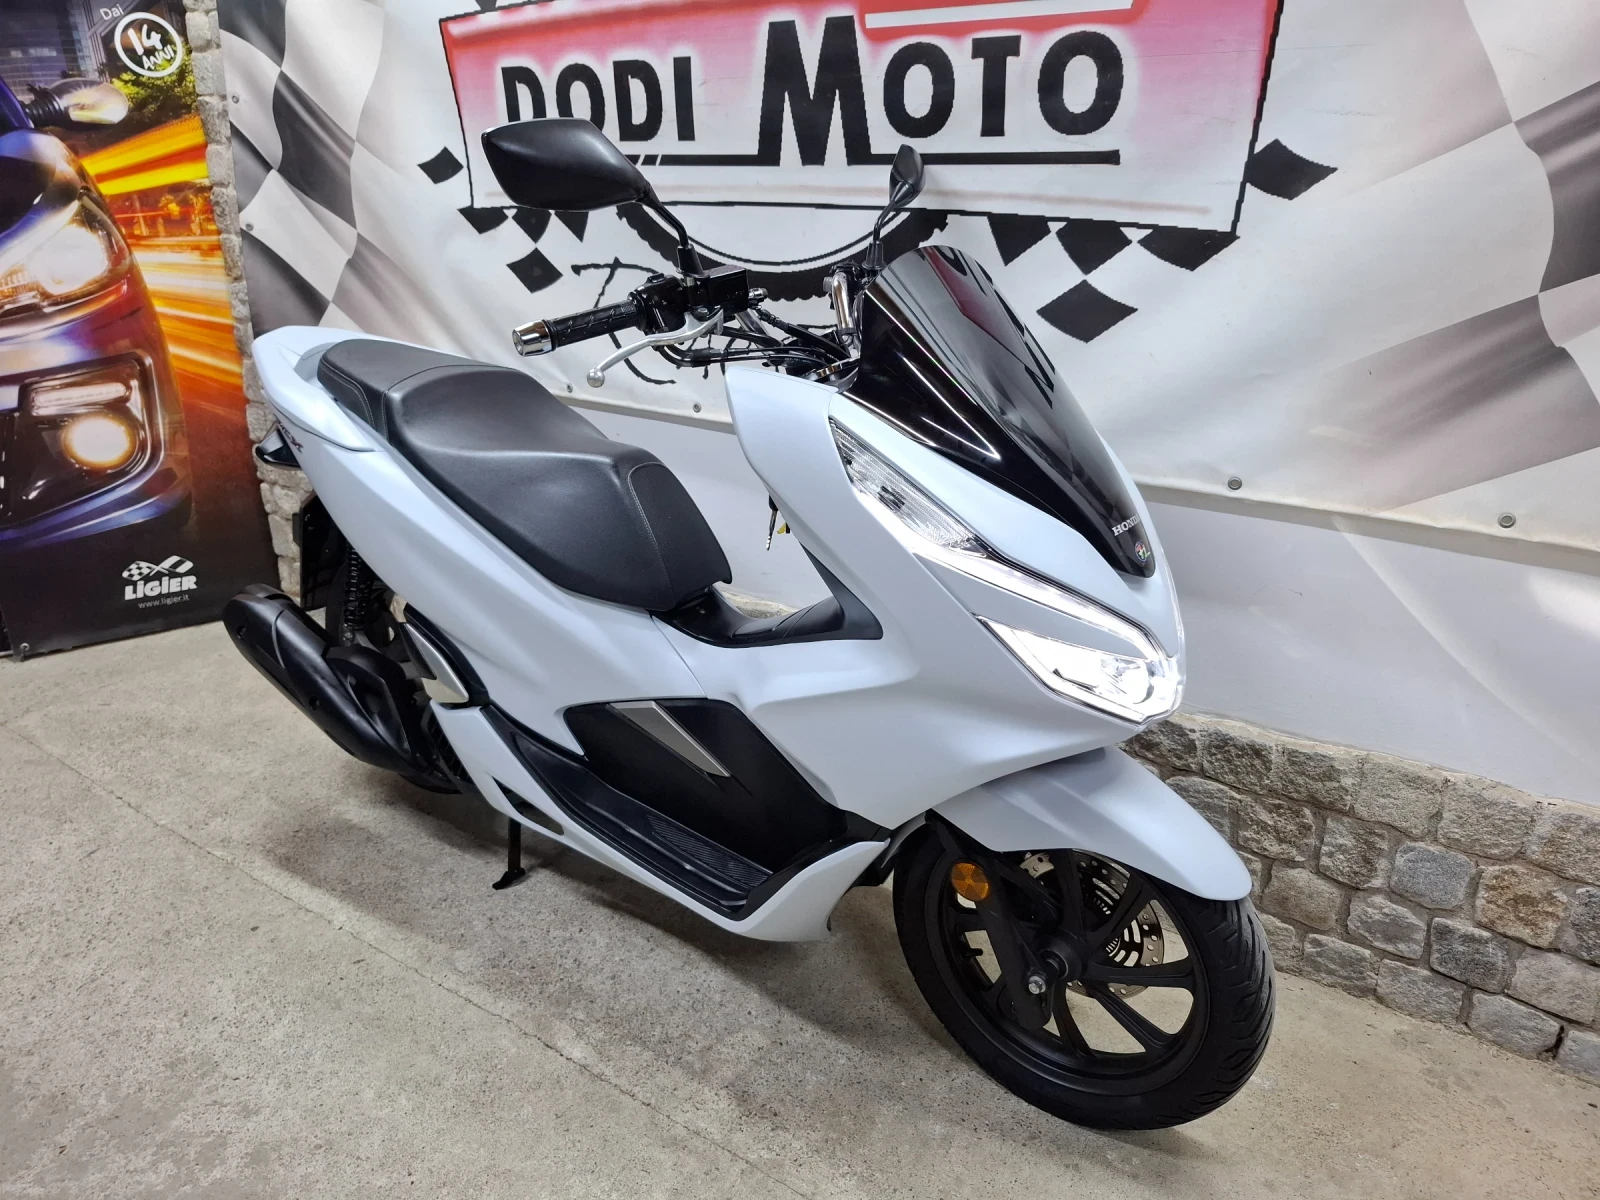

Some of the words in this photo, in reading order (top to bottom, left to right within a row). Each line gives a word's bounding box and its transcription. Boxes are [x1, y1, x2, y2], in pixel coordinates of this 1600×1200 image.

[100, 4, 124, 20] Dai
[127, 24, 163, 56] 14
[142, 44, 175, 70] ANNI
[501, 56, 695, 142] DODI
[758, 15, 1124, 167] MOTO
[137, 593, 190, 609] www.ligier.it
